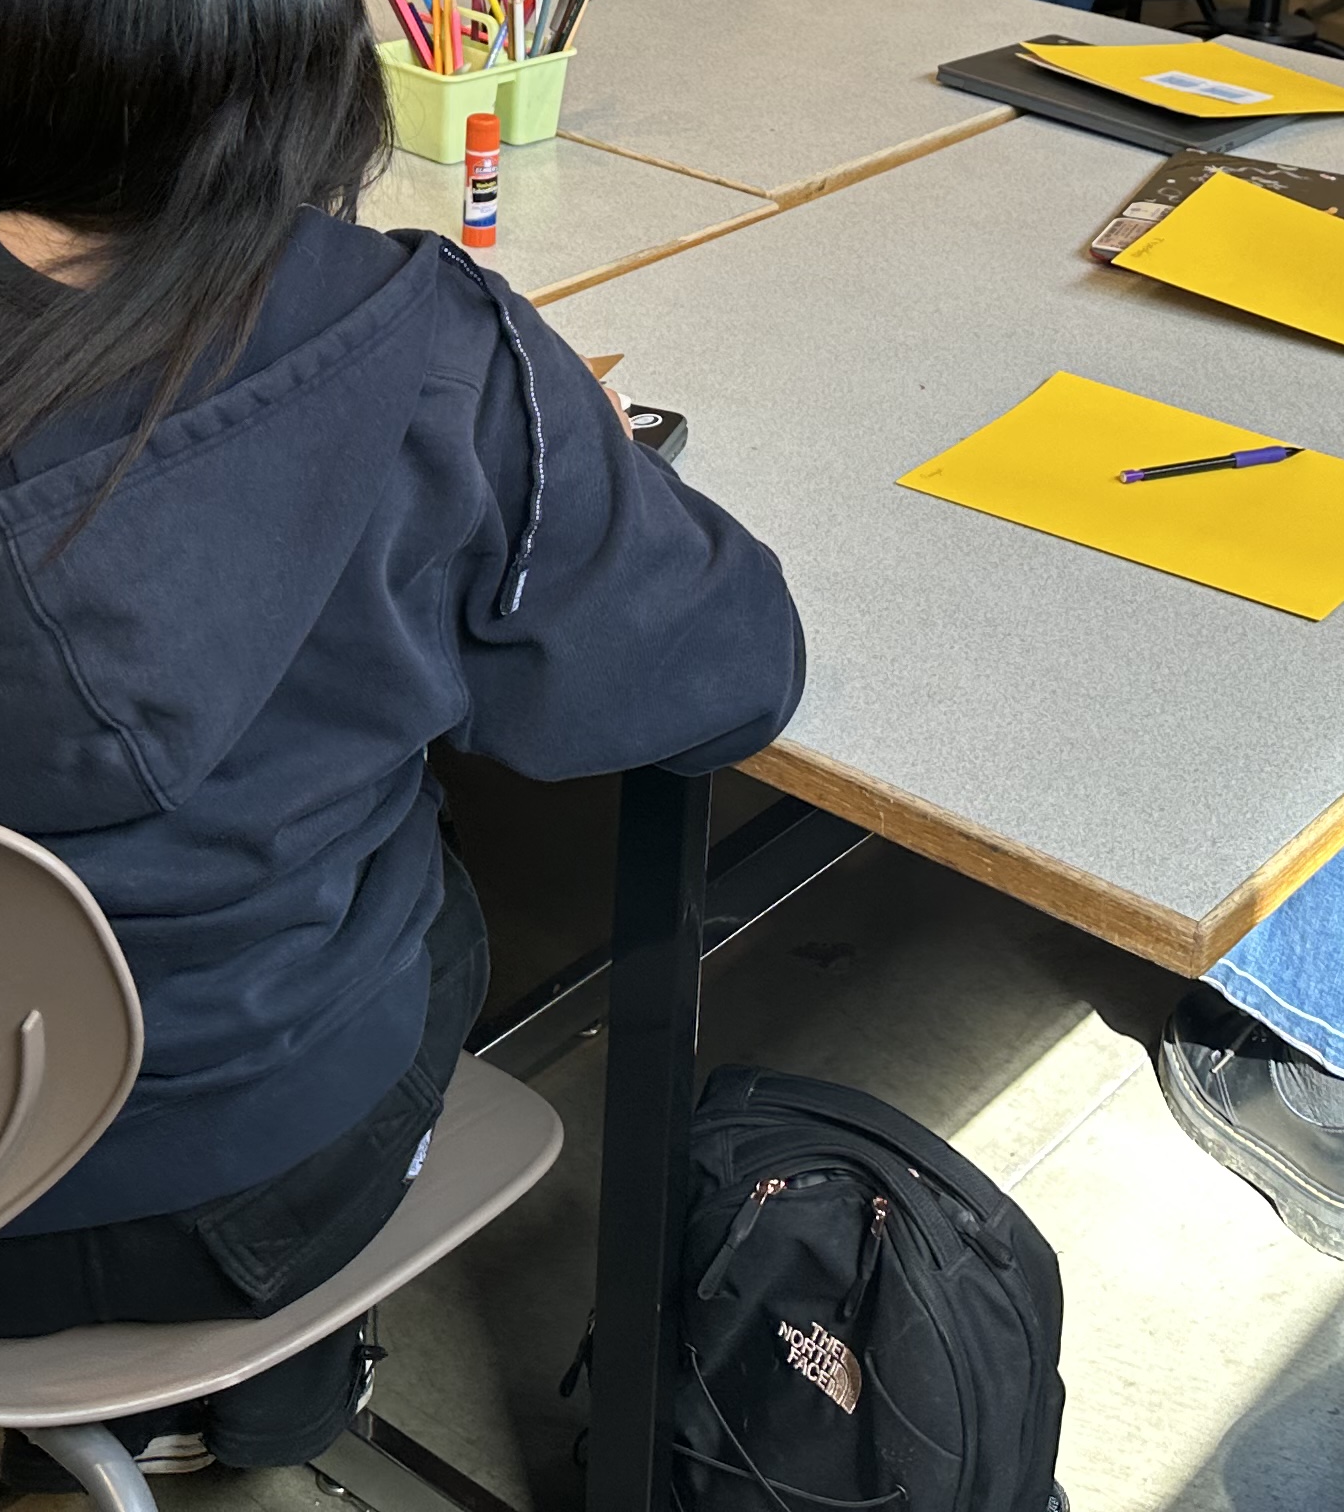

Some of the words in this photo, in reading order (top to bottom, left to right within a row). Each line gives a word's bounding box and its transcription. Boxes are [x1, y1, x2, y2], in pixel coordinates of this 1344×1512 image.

[777, 1320, 838, 1376] NORTH
[810, 1320, 844, 1360] THE
[786, 1345, 831, 1392] FACE
